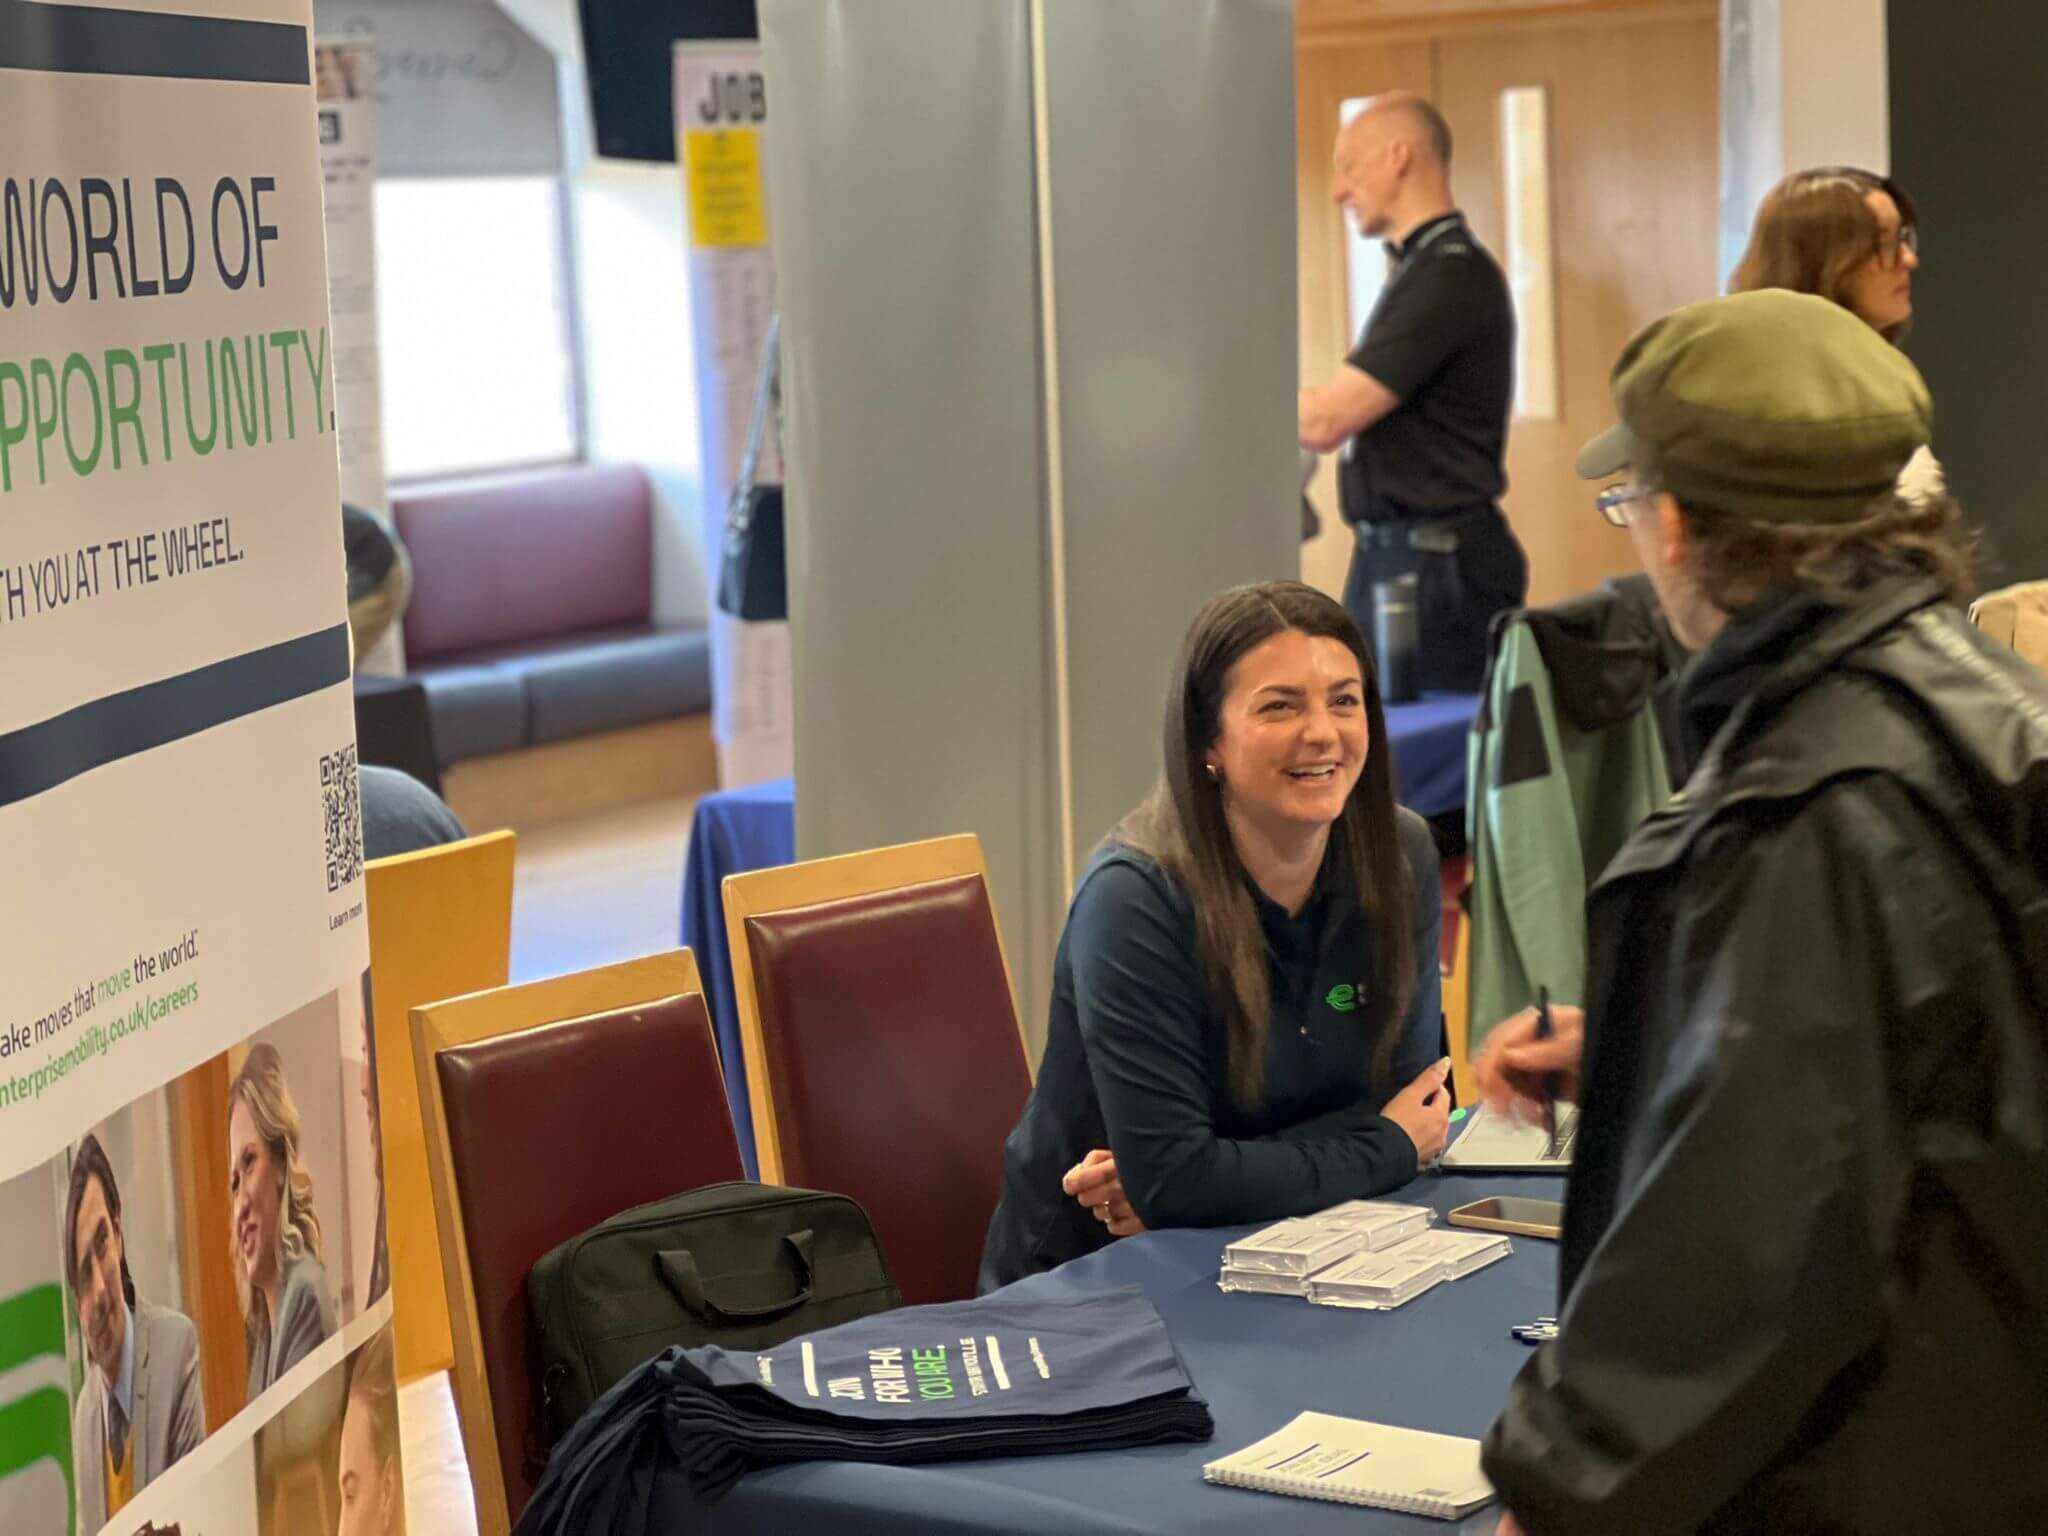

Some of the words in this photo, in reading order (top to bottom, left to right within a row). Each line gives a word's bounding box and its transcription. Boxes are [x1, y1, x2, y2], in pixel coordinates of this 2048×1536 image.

[699, 73, 767, 123] JOB
[0, 177, 195, 308] WORLD
[211, 177, 279, 290] OF
[29, 553, 70, 613] YOU
[76, 545, 101, 600] AT
[107, 534, 159, 590] THE
[162, 517, 244, 578] WHEEL.
[329, 911, 349, 931] Learn
[35, 1001, 73, 1043] moves
[74, 981, 96, 1018] that
[97, 968, 131, 1001] move
[134, 954, 156, 984] the
[872, 1379, 912, 1402] FOR
[916, 1377, 955, 1401] YOU
